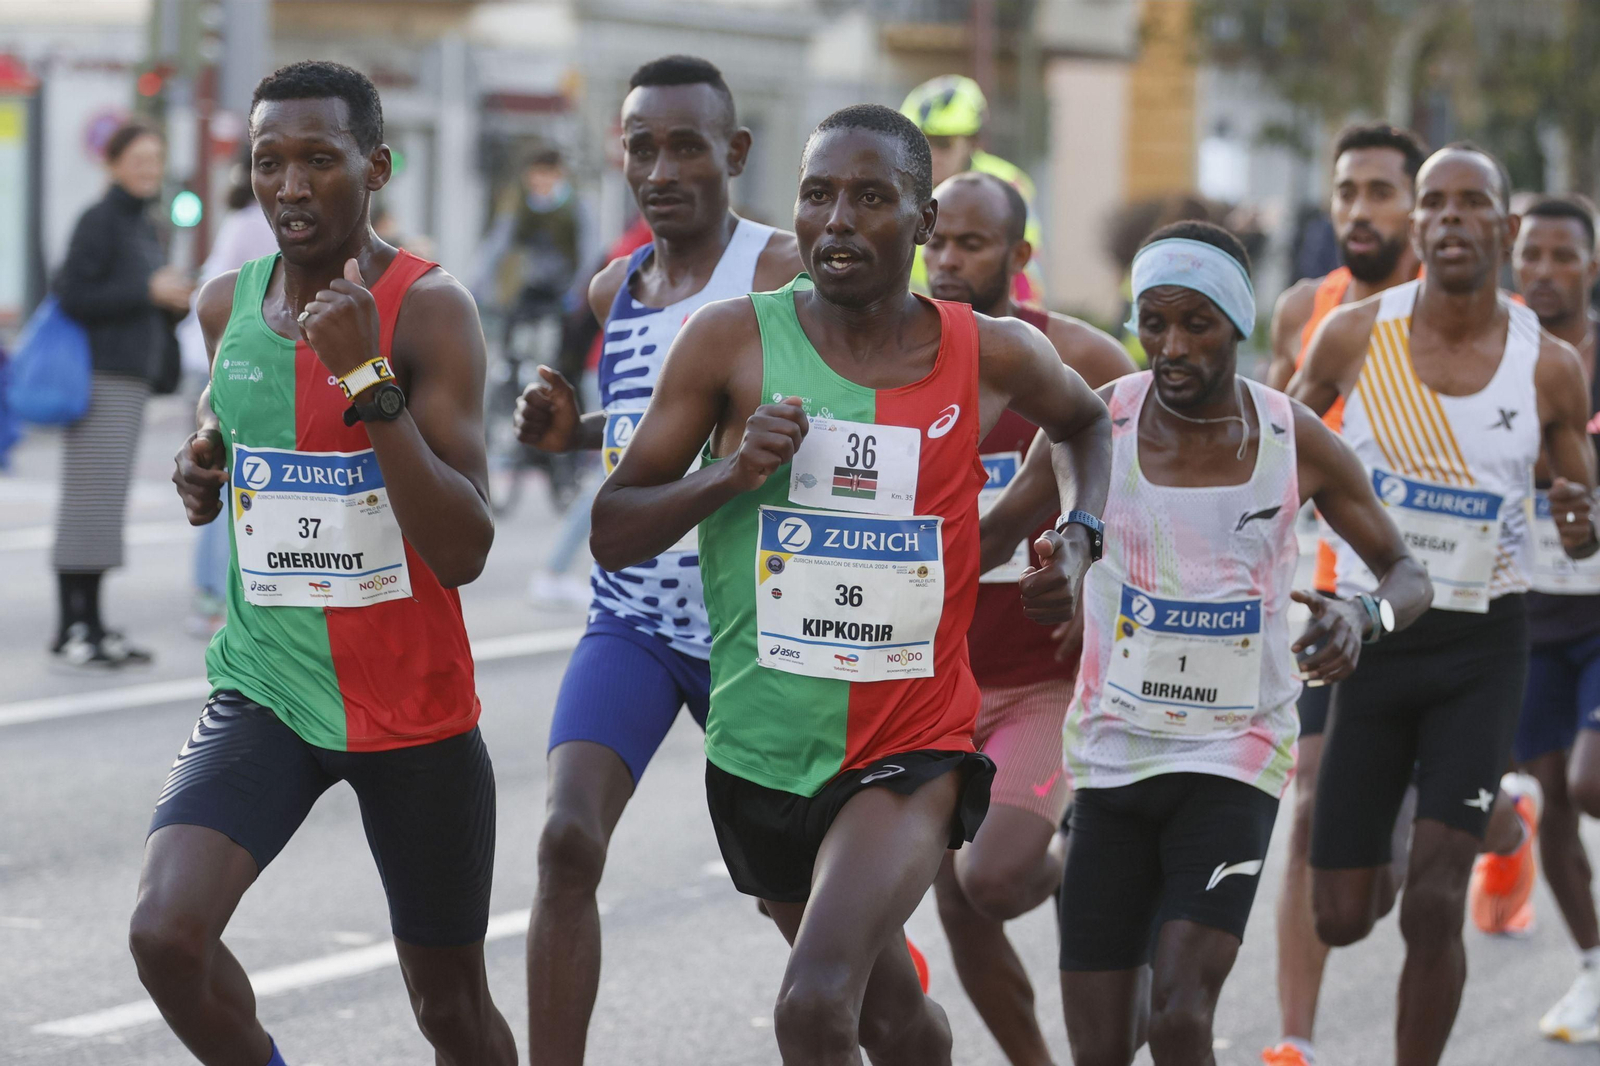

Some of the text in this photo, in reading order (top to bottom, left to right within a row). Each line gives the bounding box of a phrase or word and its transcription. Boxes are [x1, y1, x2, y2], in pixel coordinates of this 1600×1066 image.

[845, 433, 877, 470] 36
[282, 464, 364, 487] ZURICH
[1412, 488, 1488, 516] ZURICH
[298, 517, 322, 538] 37
[823, 528, 920, 552] ZURICH
[267, 552, 364, 570] CHERUIYOT
[814, 559, 842, 567] MARATÓN
[834, 584, 863, 608] 36
[802, 618, 893, 642] KIPKORIR
[1164, 610, 1246, 629] ZURICH
[1178, 655, 1187, 673] 1
[1141, 680, 1218, 703] BIRHANU
